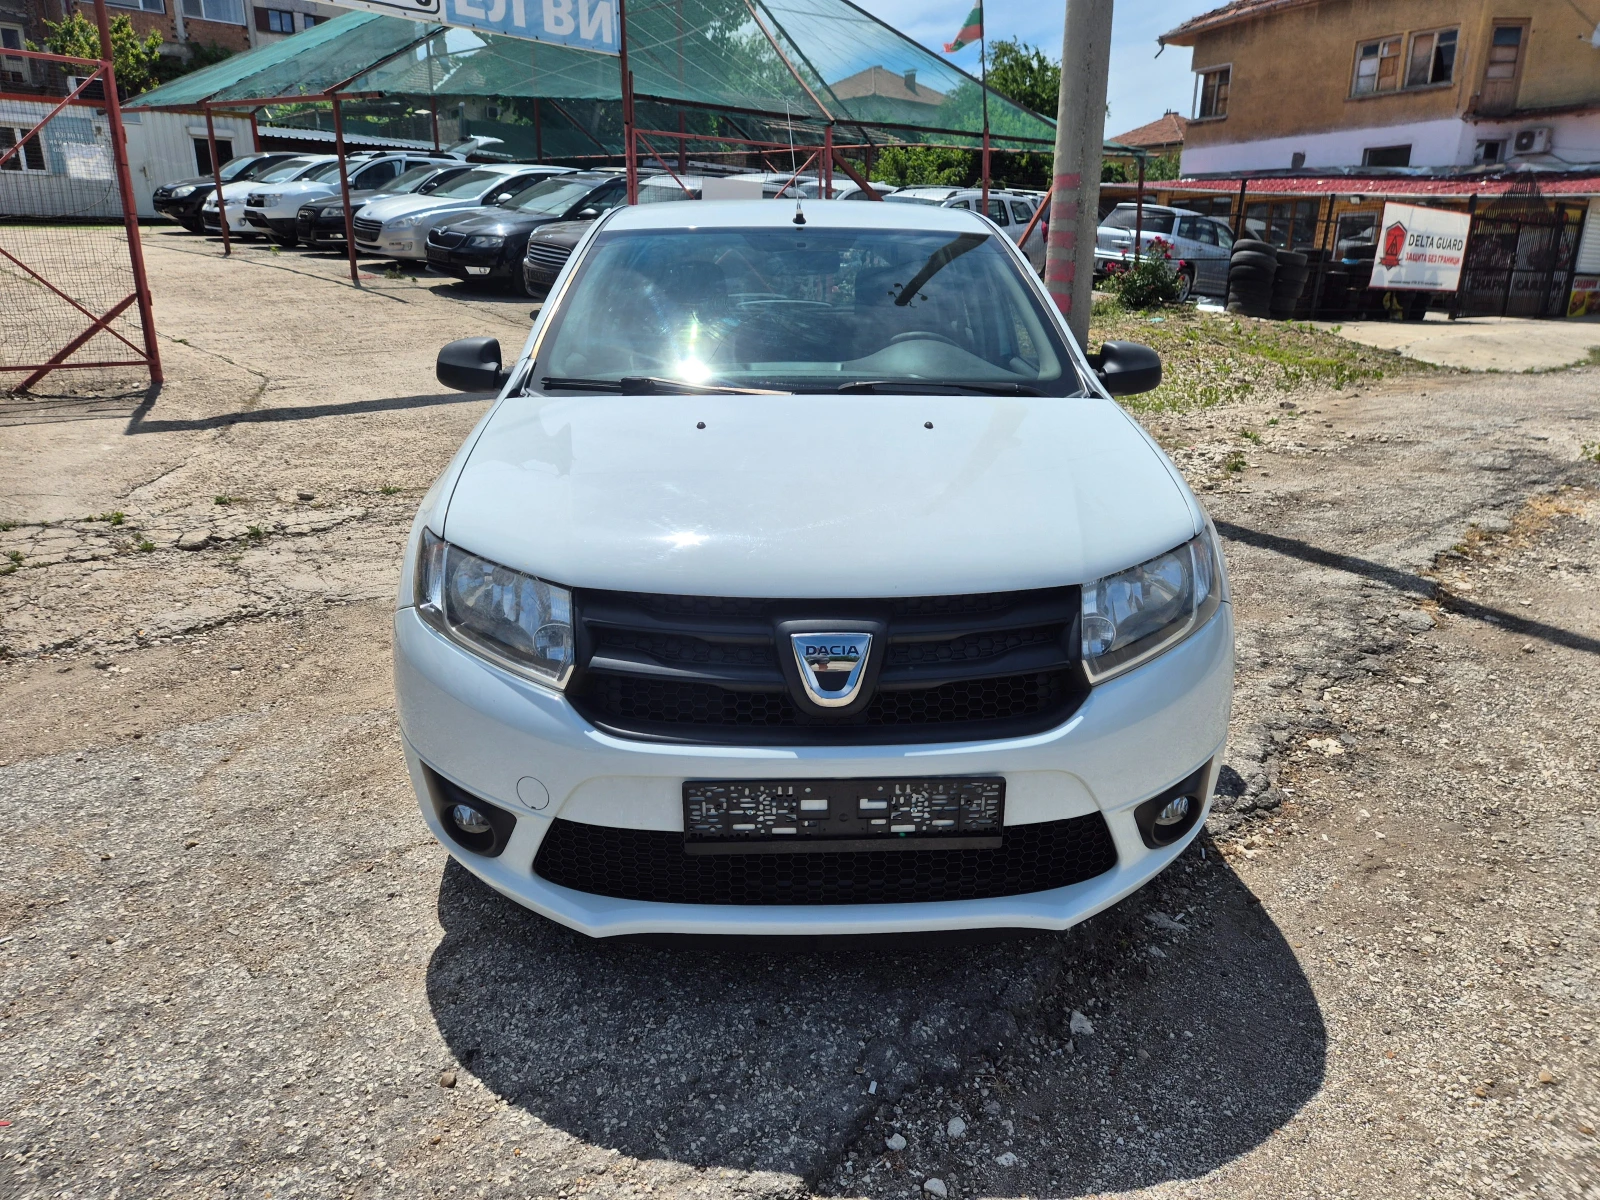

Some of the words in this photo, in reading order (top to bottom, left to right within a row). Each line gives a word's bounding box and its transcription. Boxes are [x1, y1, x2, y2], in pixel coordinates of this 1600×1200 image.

[543, 0, 612, 44] ВИ
[1408, 234, 1434, 249] DELTA
[1436, 237, 1463, 251] GUARD
[1405, 252, 1427, 263] ЗАЩИТА
[1428, 254, 1437, 263] БЕЗ
[1437, 255, 1460, 266] ГРАНИЦИ
[805, 645, 859, 655] DACIA
